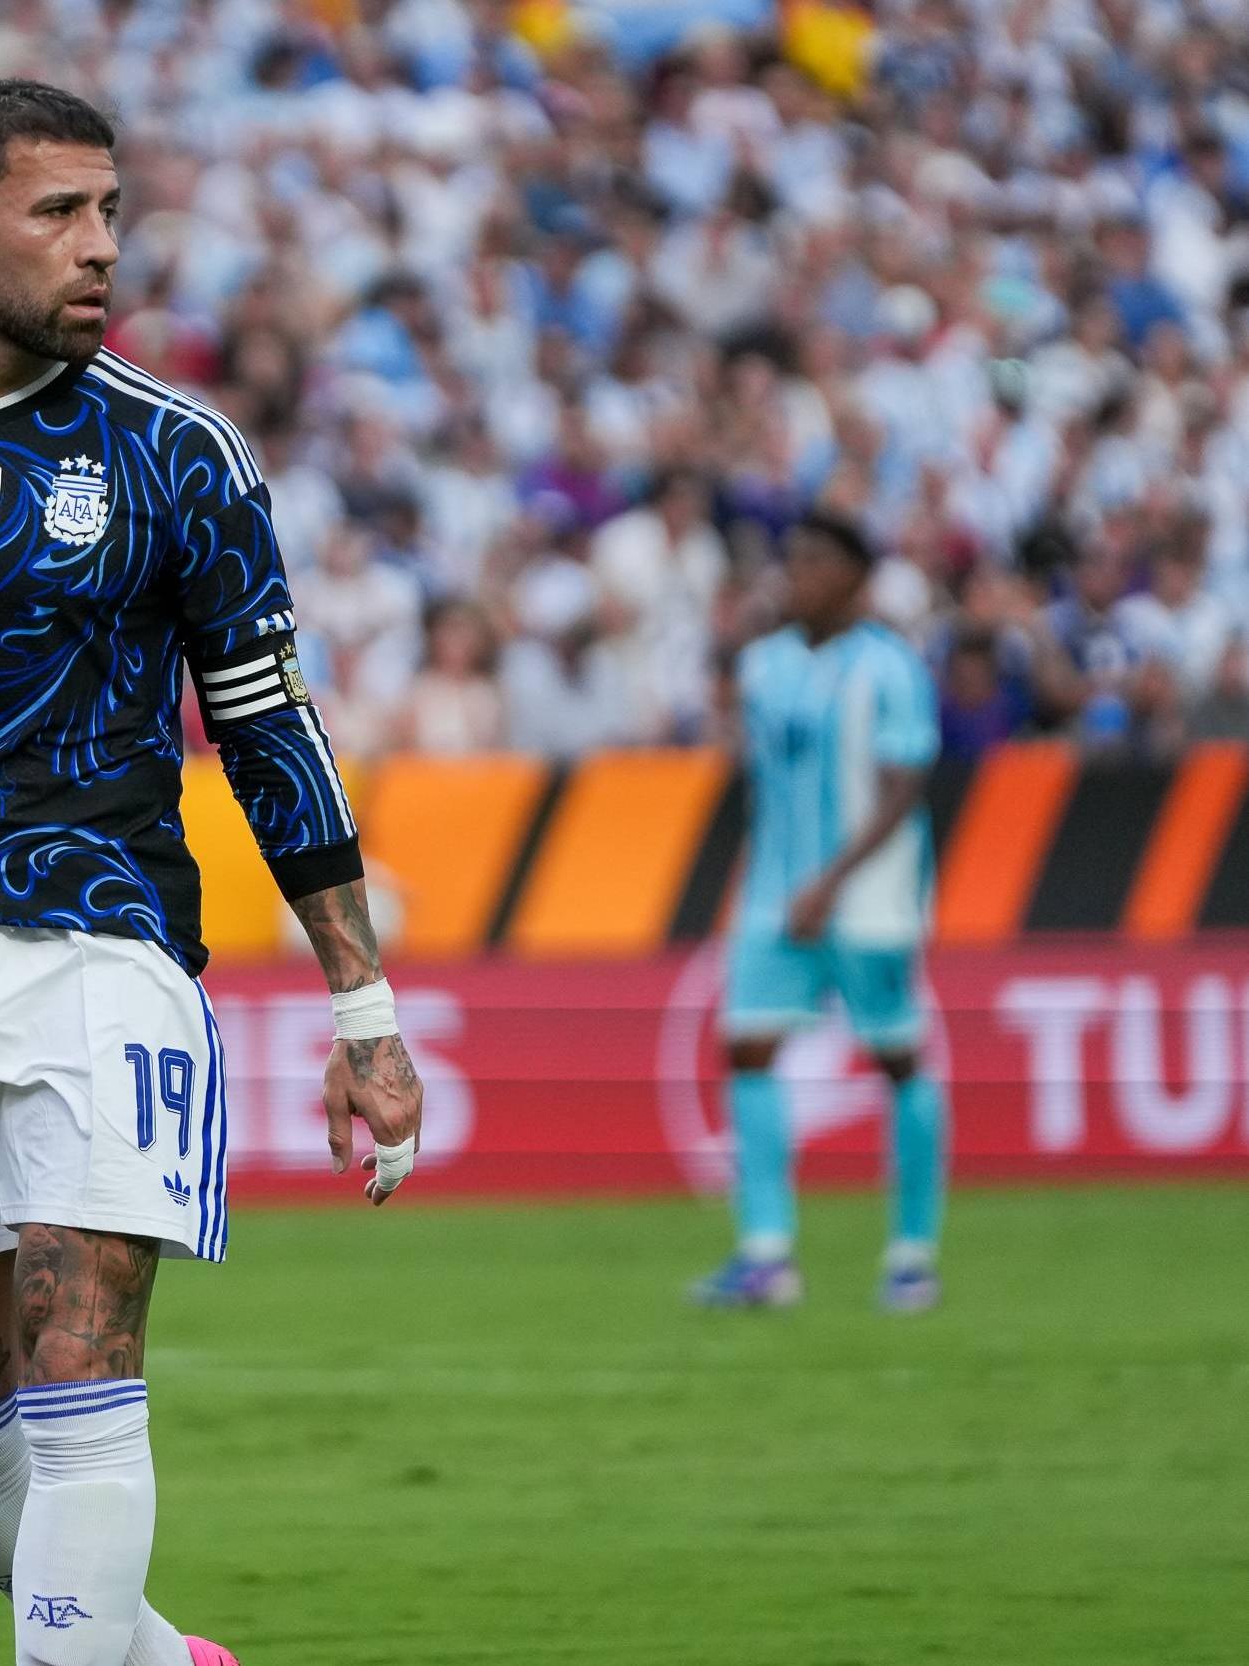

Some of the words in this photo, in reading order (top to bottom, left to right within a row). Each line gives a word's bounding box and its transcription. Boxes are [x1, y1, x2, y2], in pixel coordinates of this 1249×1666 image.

[59, 492, 94, 525] AFA
[994, 972, 1249, 1154] TU
[124, 1043, 197, 1161] 19
[26, 1593, 93, 1629] AFA
